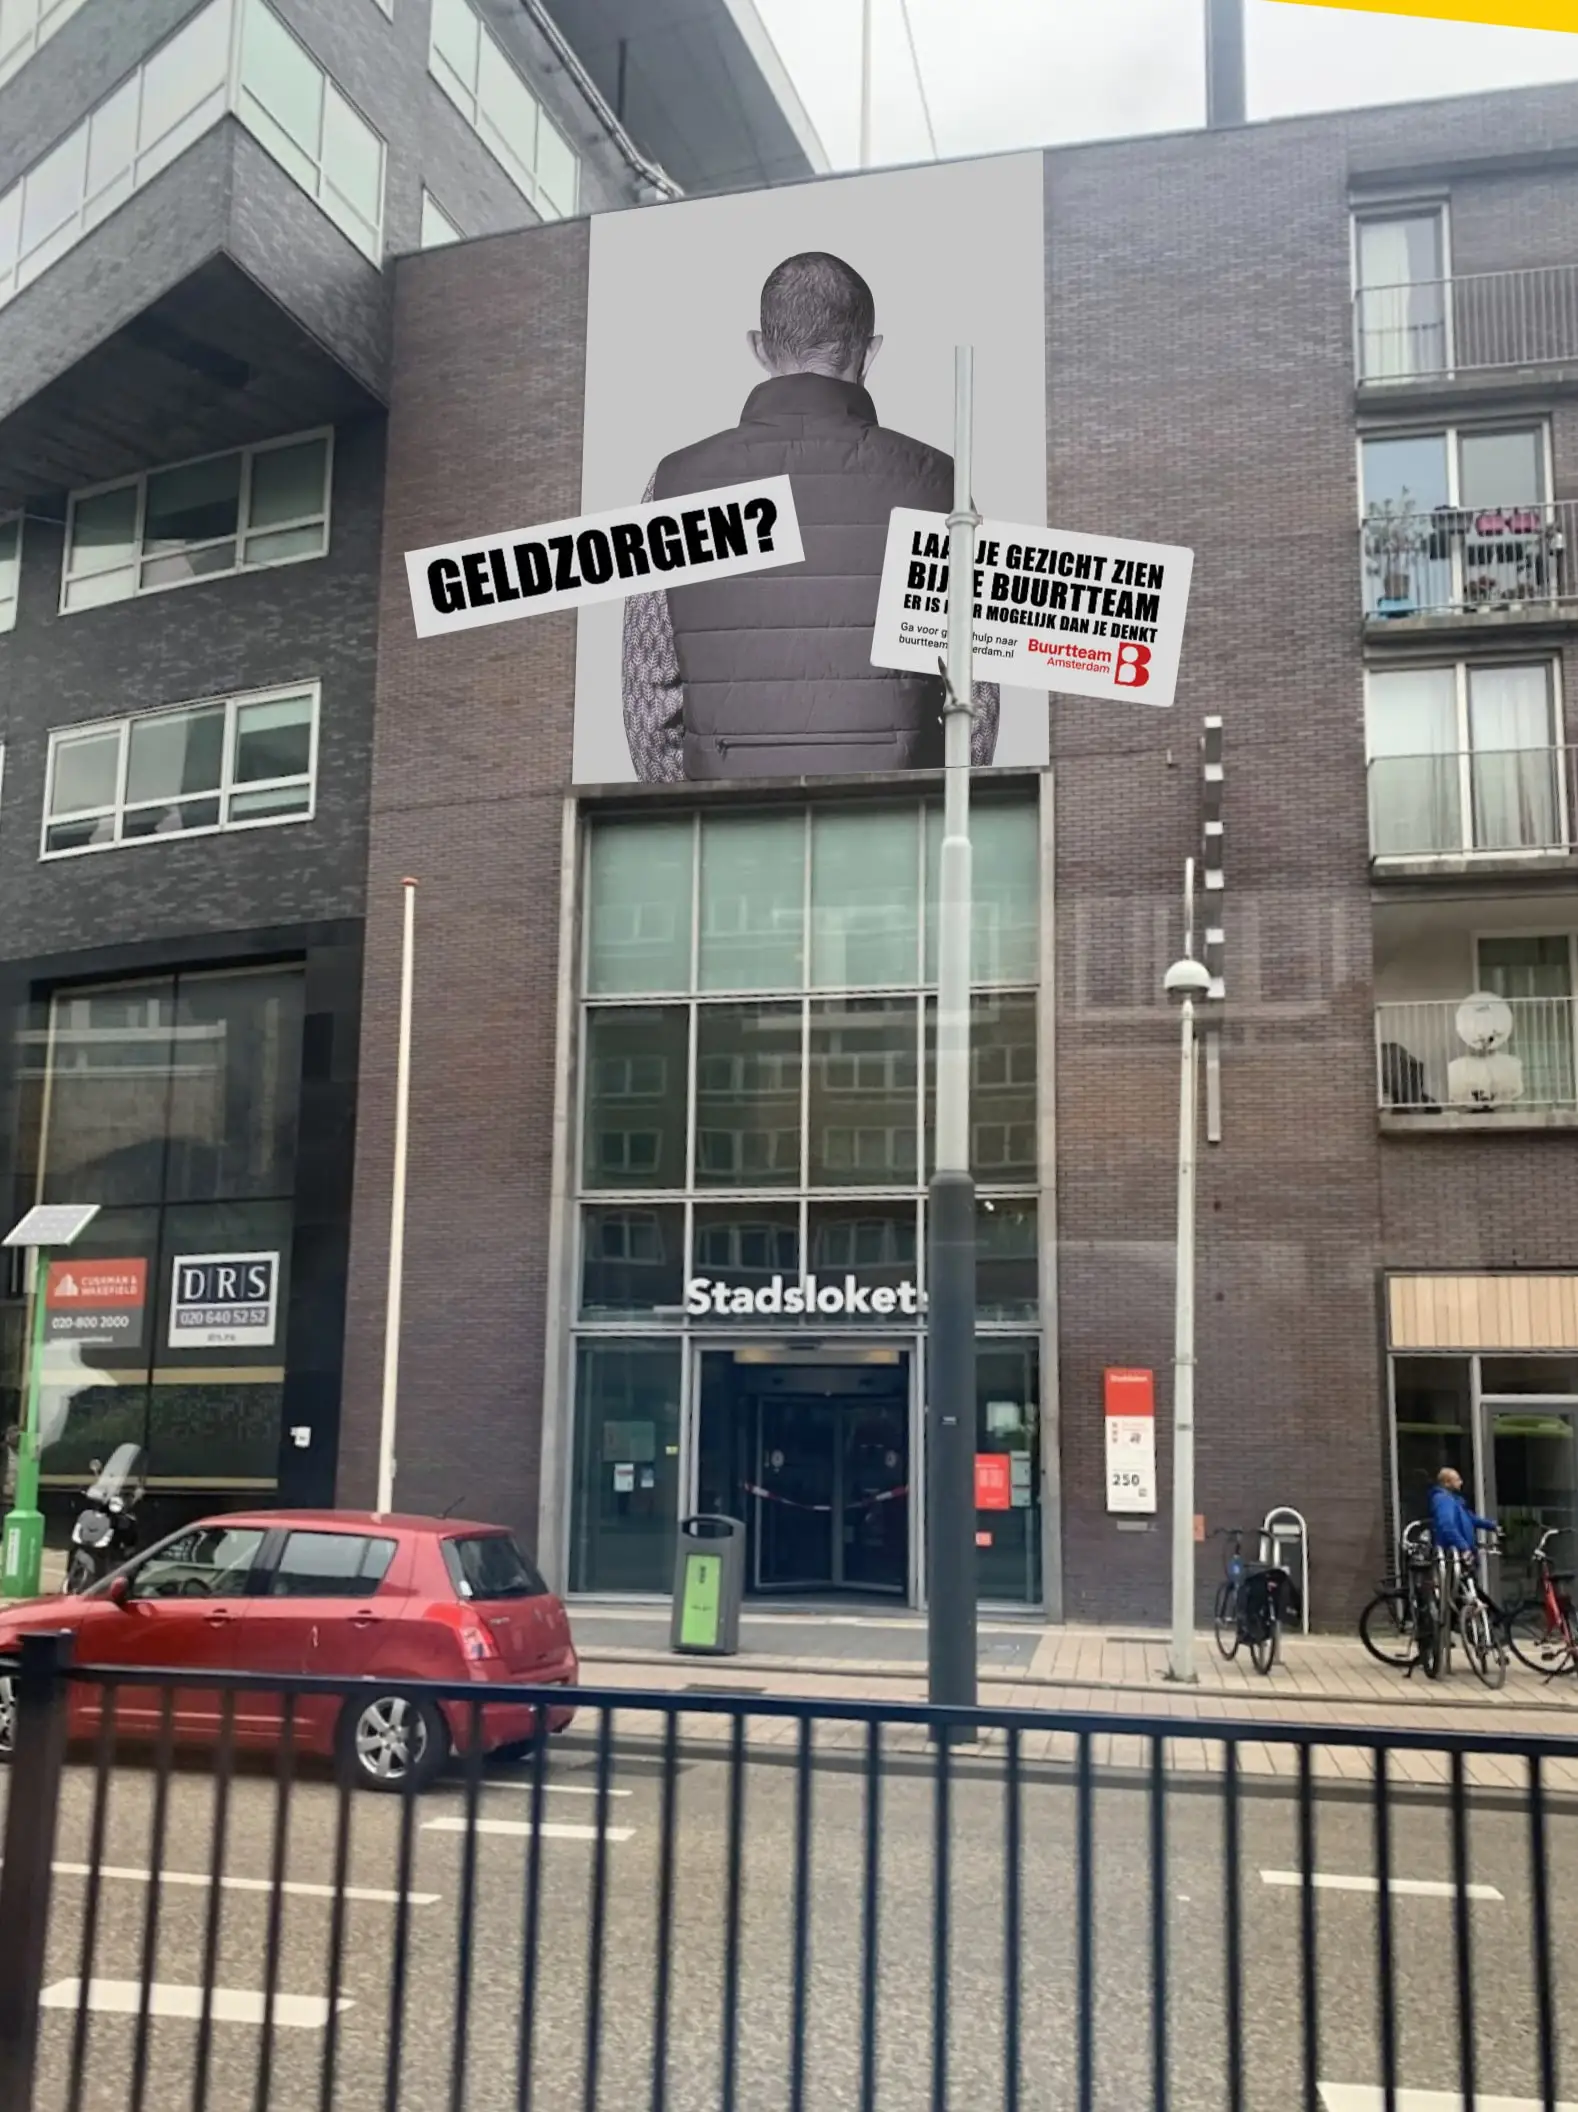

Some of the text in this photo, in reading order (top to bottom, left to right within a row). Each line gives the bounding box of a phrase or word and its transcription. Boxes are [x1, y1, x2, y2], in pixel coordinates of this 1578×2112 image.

[427, 497, 777, 614] GELDZORGEN?
[911, 531, 1164, 590] LAA JE GEZICHT ZIEN
[991, 572, 1160, 623] BUURTTEAM
[901, 622, 914, 632] Ga
[917, 627, 939, 636] voor
[972, 632, 993, 643] hulp
[995, 636, 1018, 647] naar
[903, 593, 922, 611] ER
[925, 596, 940, 613] IS
[986, 605, 1057, 630] MOGELIJK
[1060, 616, 1089, 634] DAN
[1092, 620, 1107, 636] JE
[1110, 623, 1158, 643] DENKT
[1028, 638, 1112, 662] Buurtteam
[1046, 657, 1110, 673] Amsterdam
[1114, 641, 1152, 687] B
[181, 1311, 204, 1325] 020
[205, 1310, 231, 1324] 640
[1112, 1473, 1140, 1487] 250
